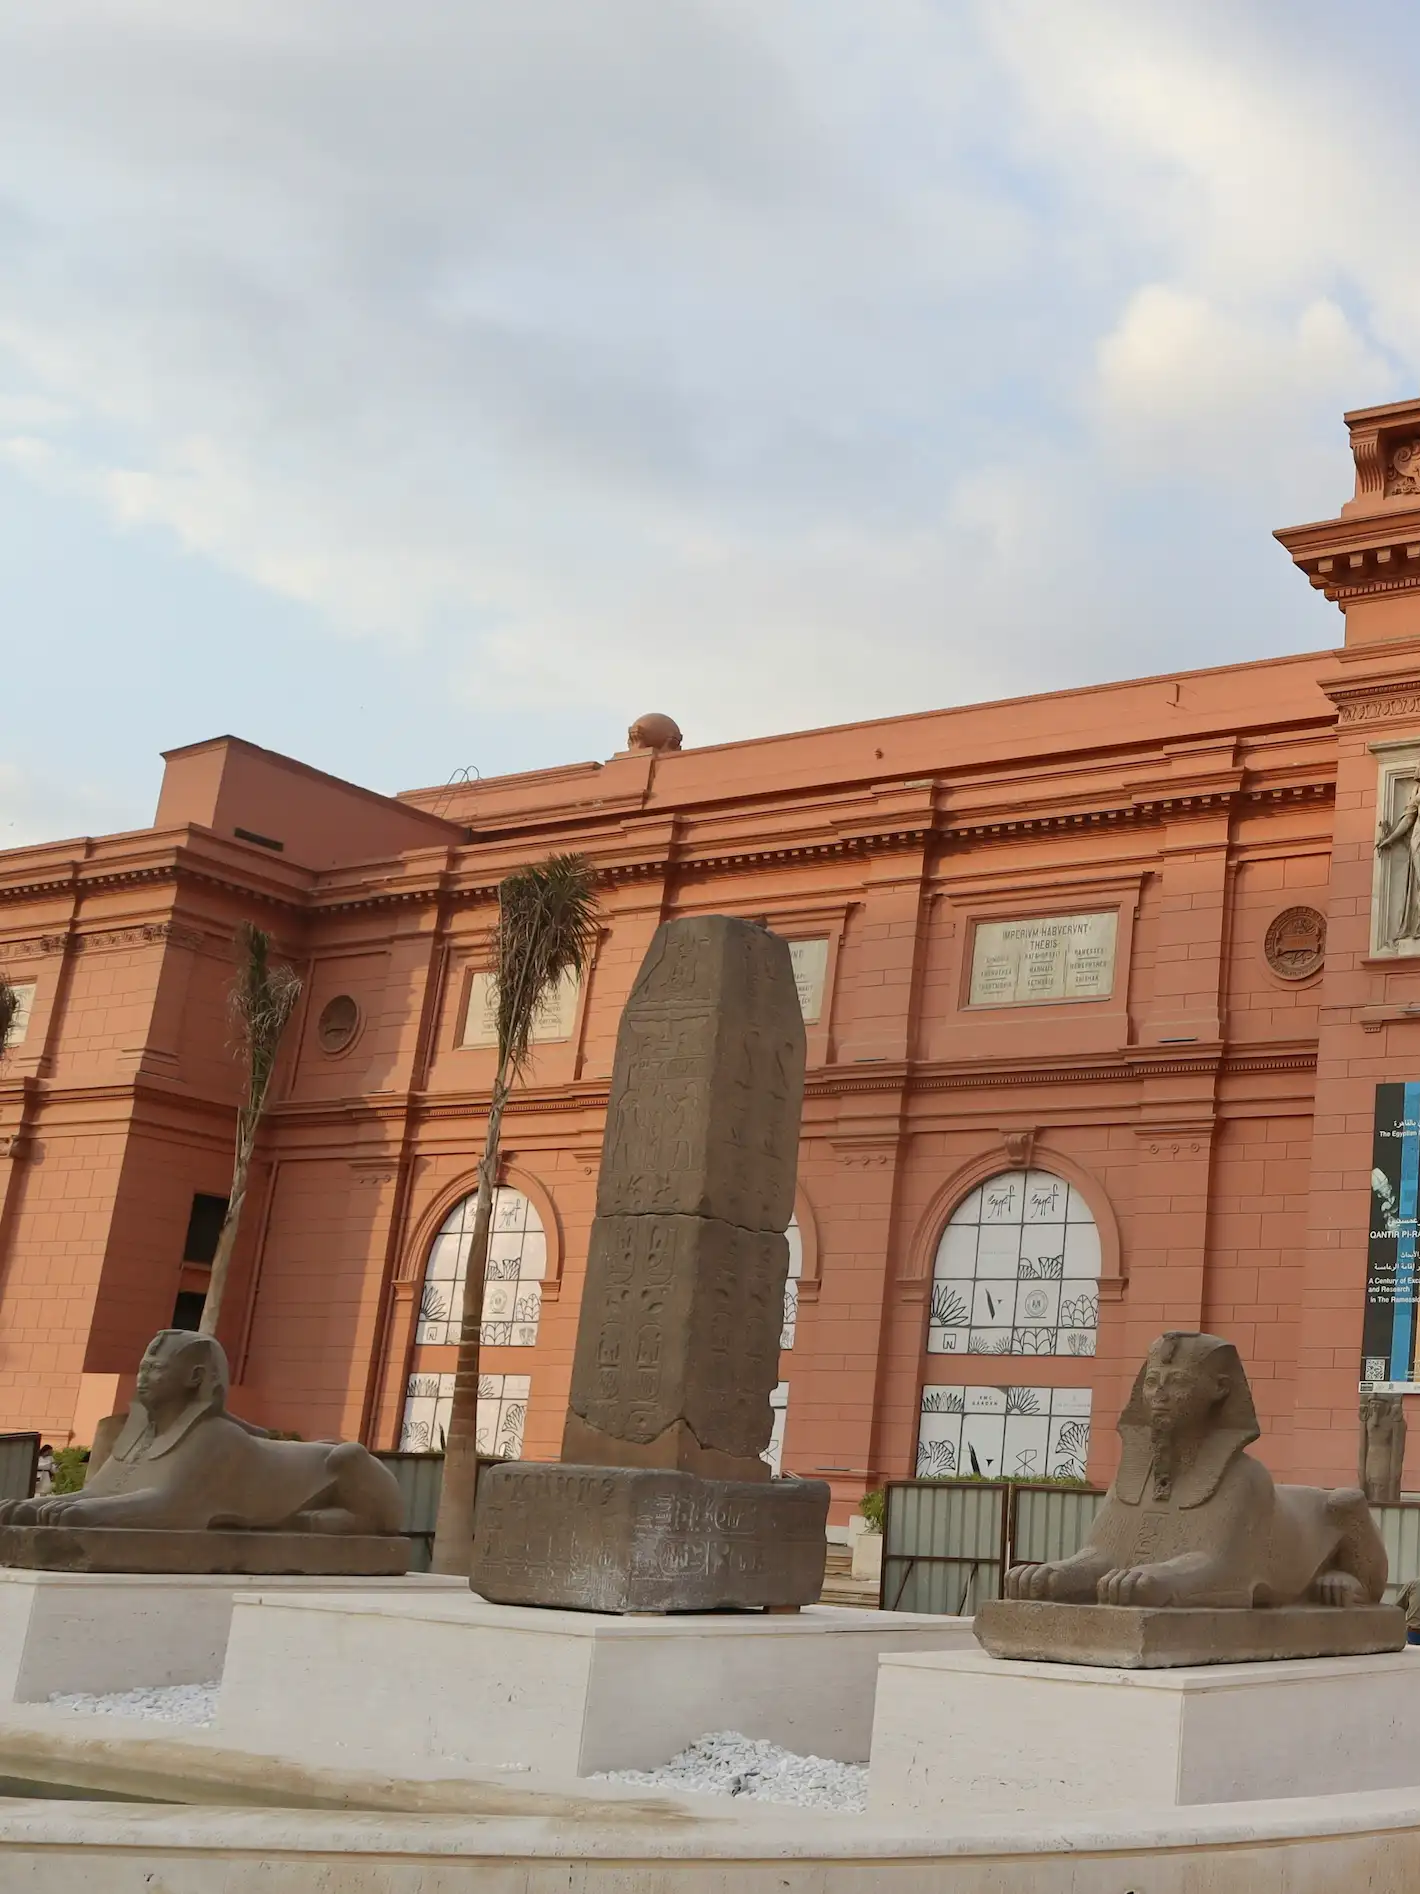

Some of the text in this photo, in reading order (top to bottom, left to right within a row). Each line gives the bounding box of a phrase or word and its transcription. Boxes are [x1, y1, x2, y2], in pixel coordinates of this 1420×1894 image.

[1391, 1129, 1417, 1138] Egyptian
[1370, 1230, 1400, 1239] QANTIR
[1368, 1277, 1374, 1285] A
[1375, 1277, 1399, 1286] Century
[1400, 1276, 1407, 1284] of
